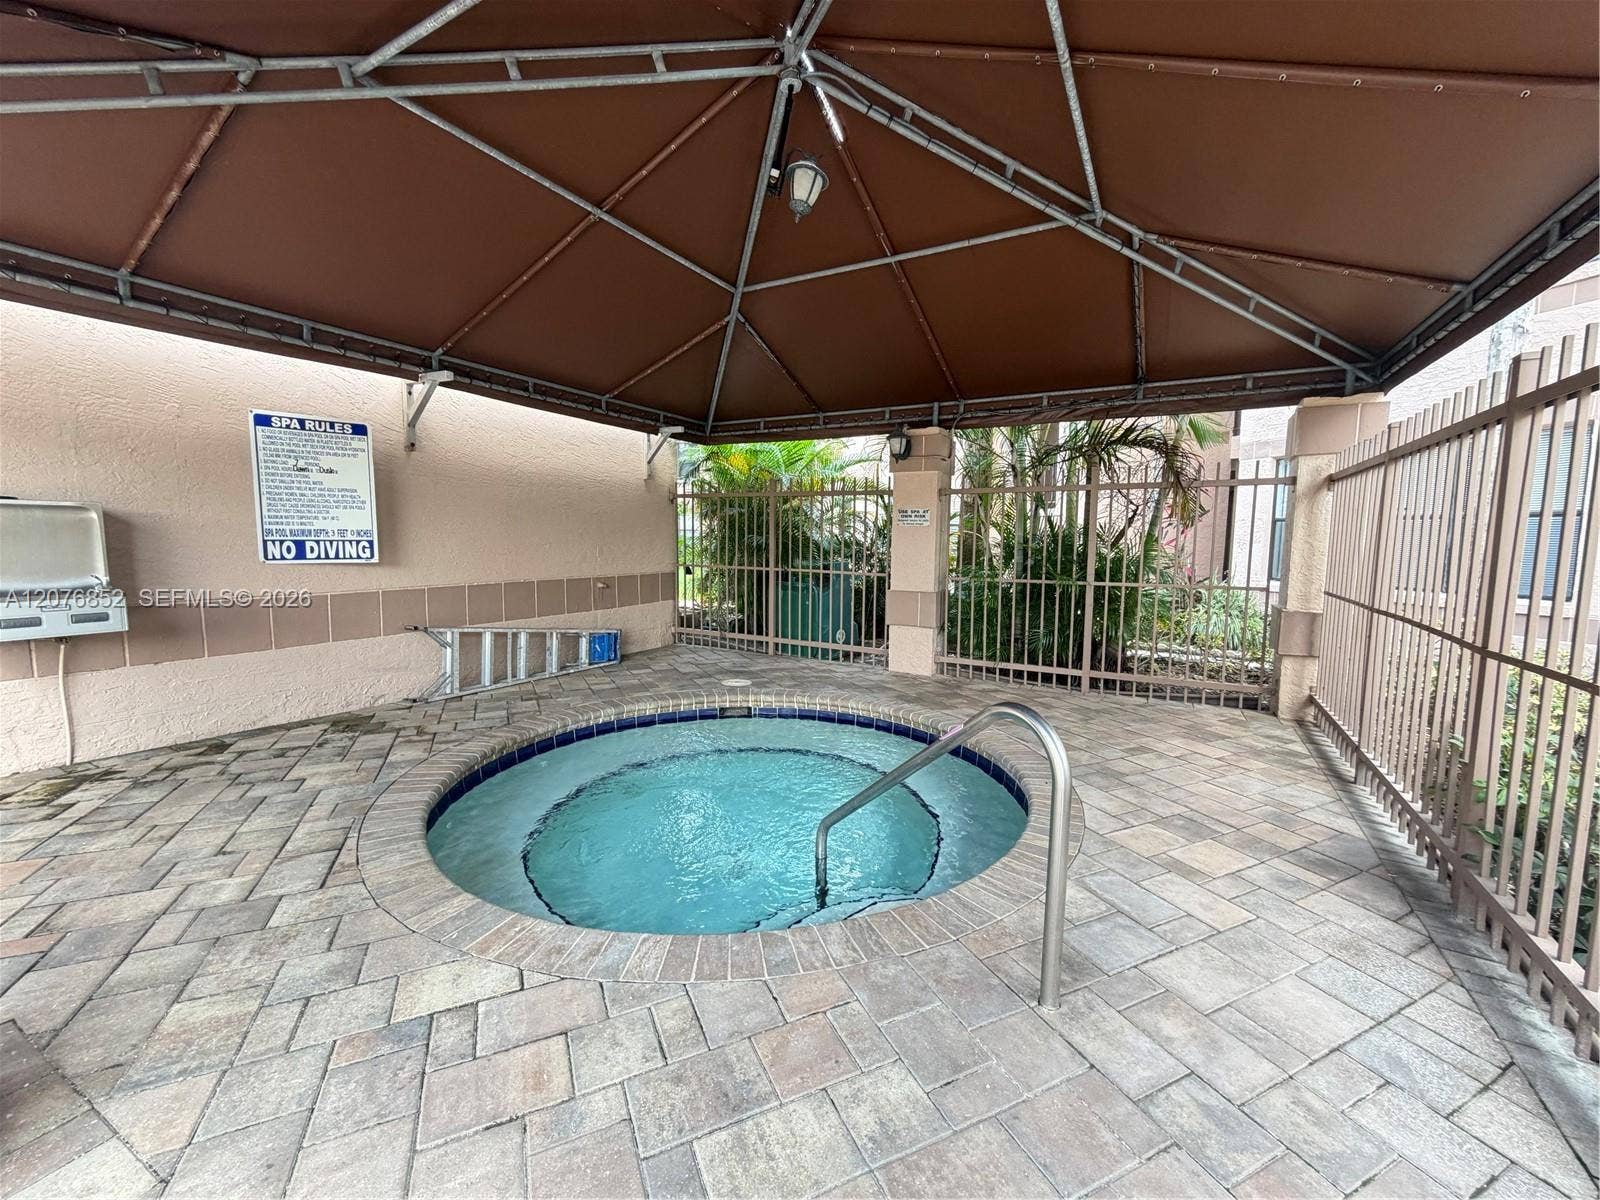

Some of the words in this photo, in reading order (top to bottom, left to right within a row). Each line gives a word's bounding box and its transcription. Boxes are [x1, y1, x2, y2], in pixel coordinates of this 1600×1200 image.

[271, 416, 300, 429] SPA
[305, 420, 352, 434] RULES
[264, 528, 274, 538] SPA
[275, 528, 289, 538] POOL
[289, 528, 312, 538] MAXIMUM
[337, 529, 349, 538] FEET
[355, 530, 372, 538] INCHES
[266, 540, 296, 560] NO
[305, 540, 371, 559] DIVING
